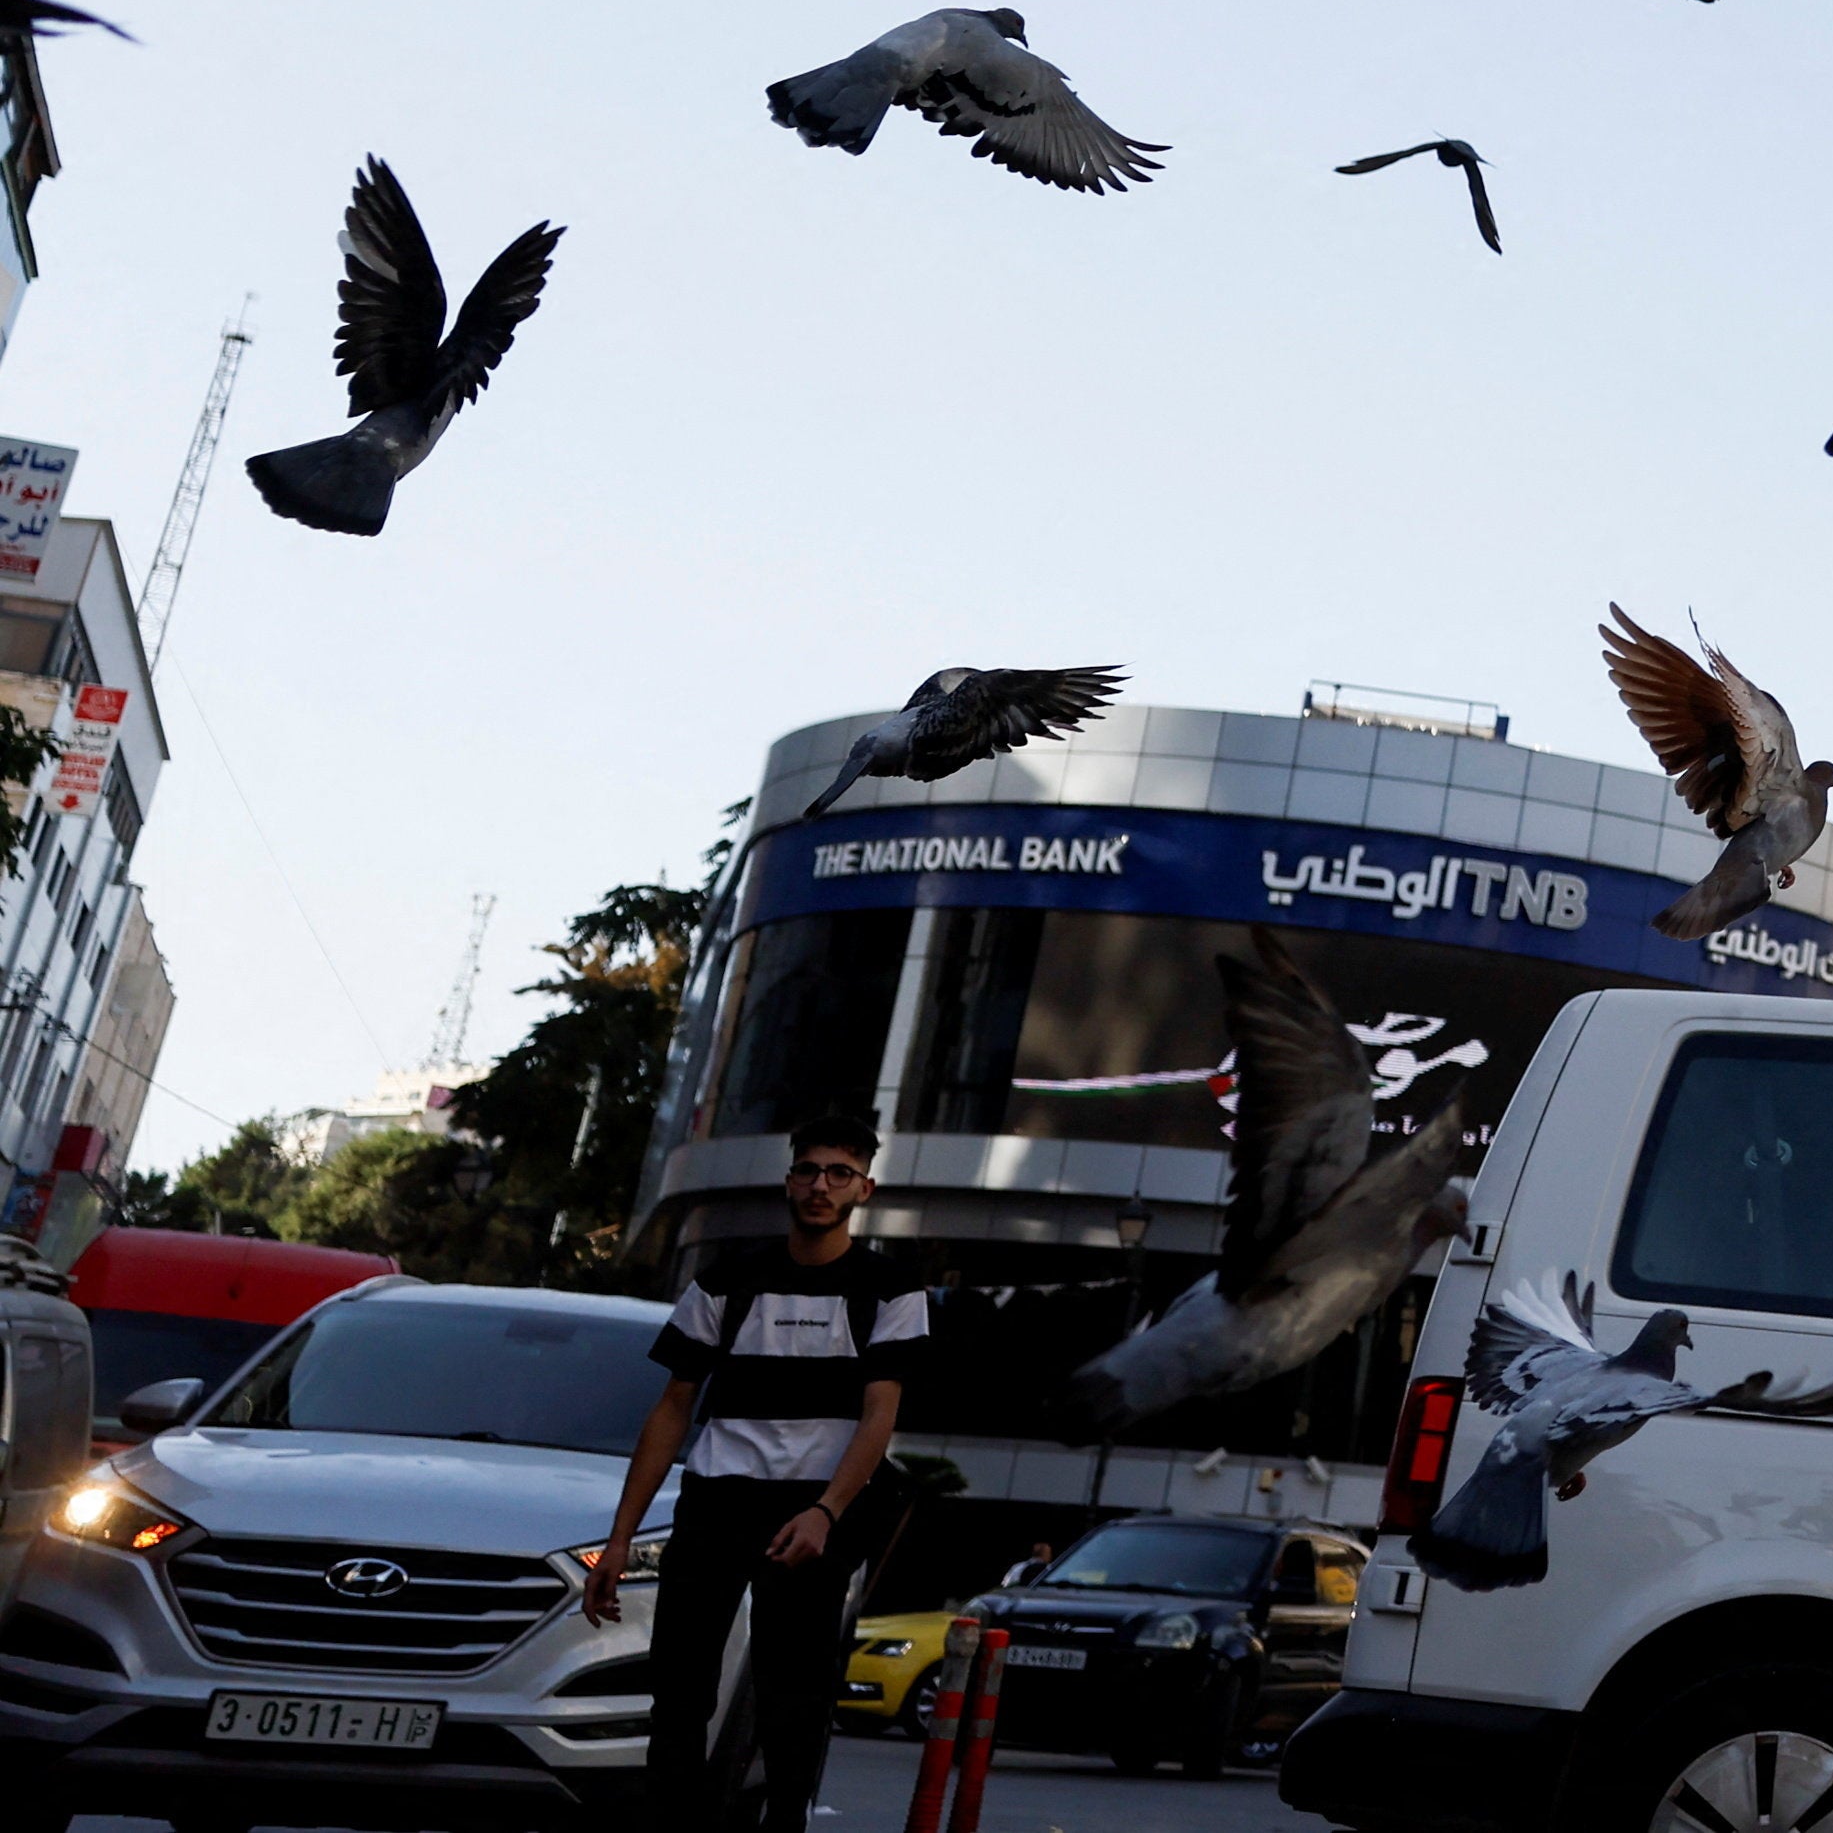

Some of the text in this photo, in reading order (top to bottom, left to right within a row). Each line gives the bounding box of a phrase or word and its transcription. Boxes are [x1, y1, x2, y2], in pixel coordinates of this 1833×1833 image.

[812, 834, 1130, 879] THE NATIONAL BANK
[1262, 844, 1589, 931] الوطني TNB
[1705, 923, 1818, 981] الوطني
